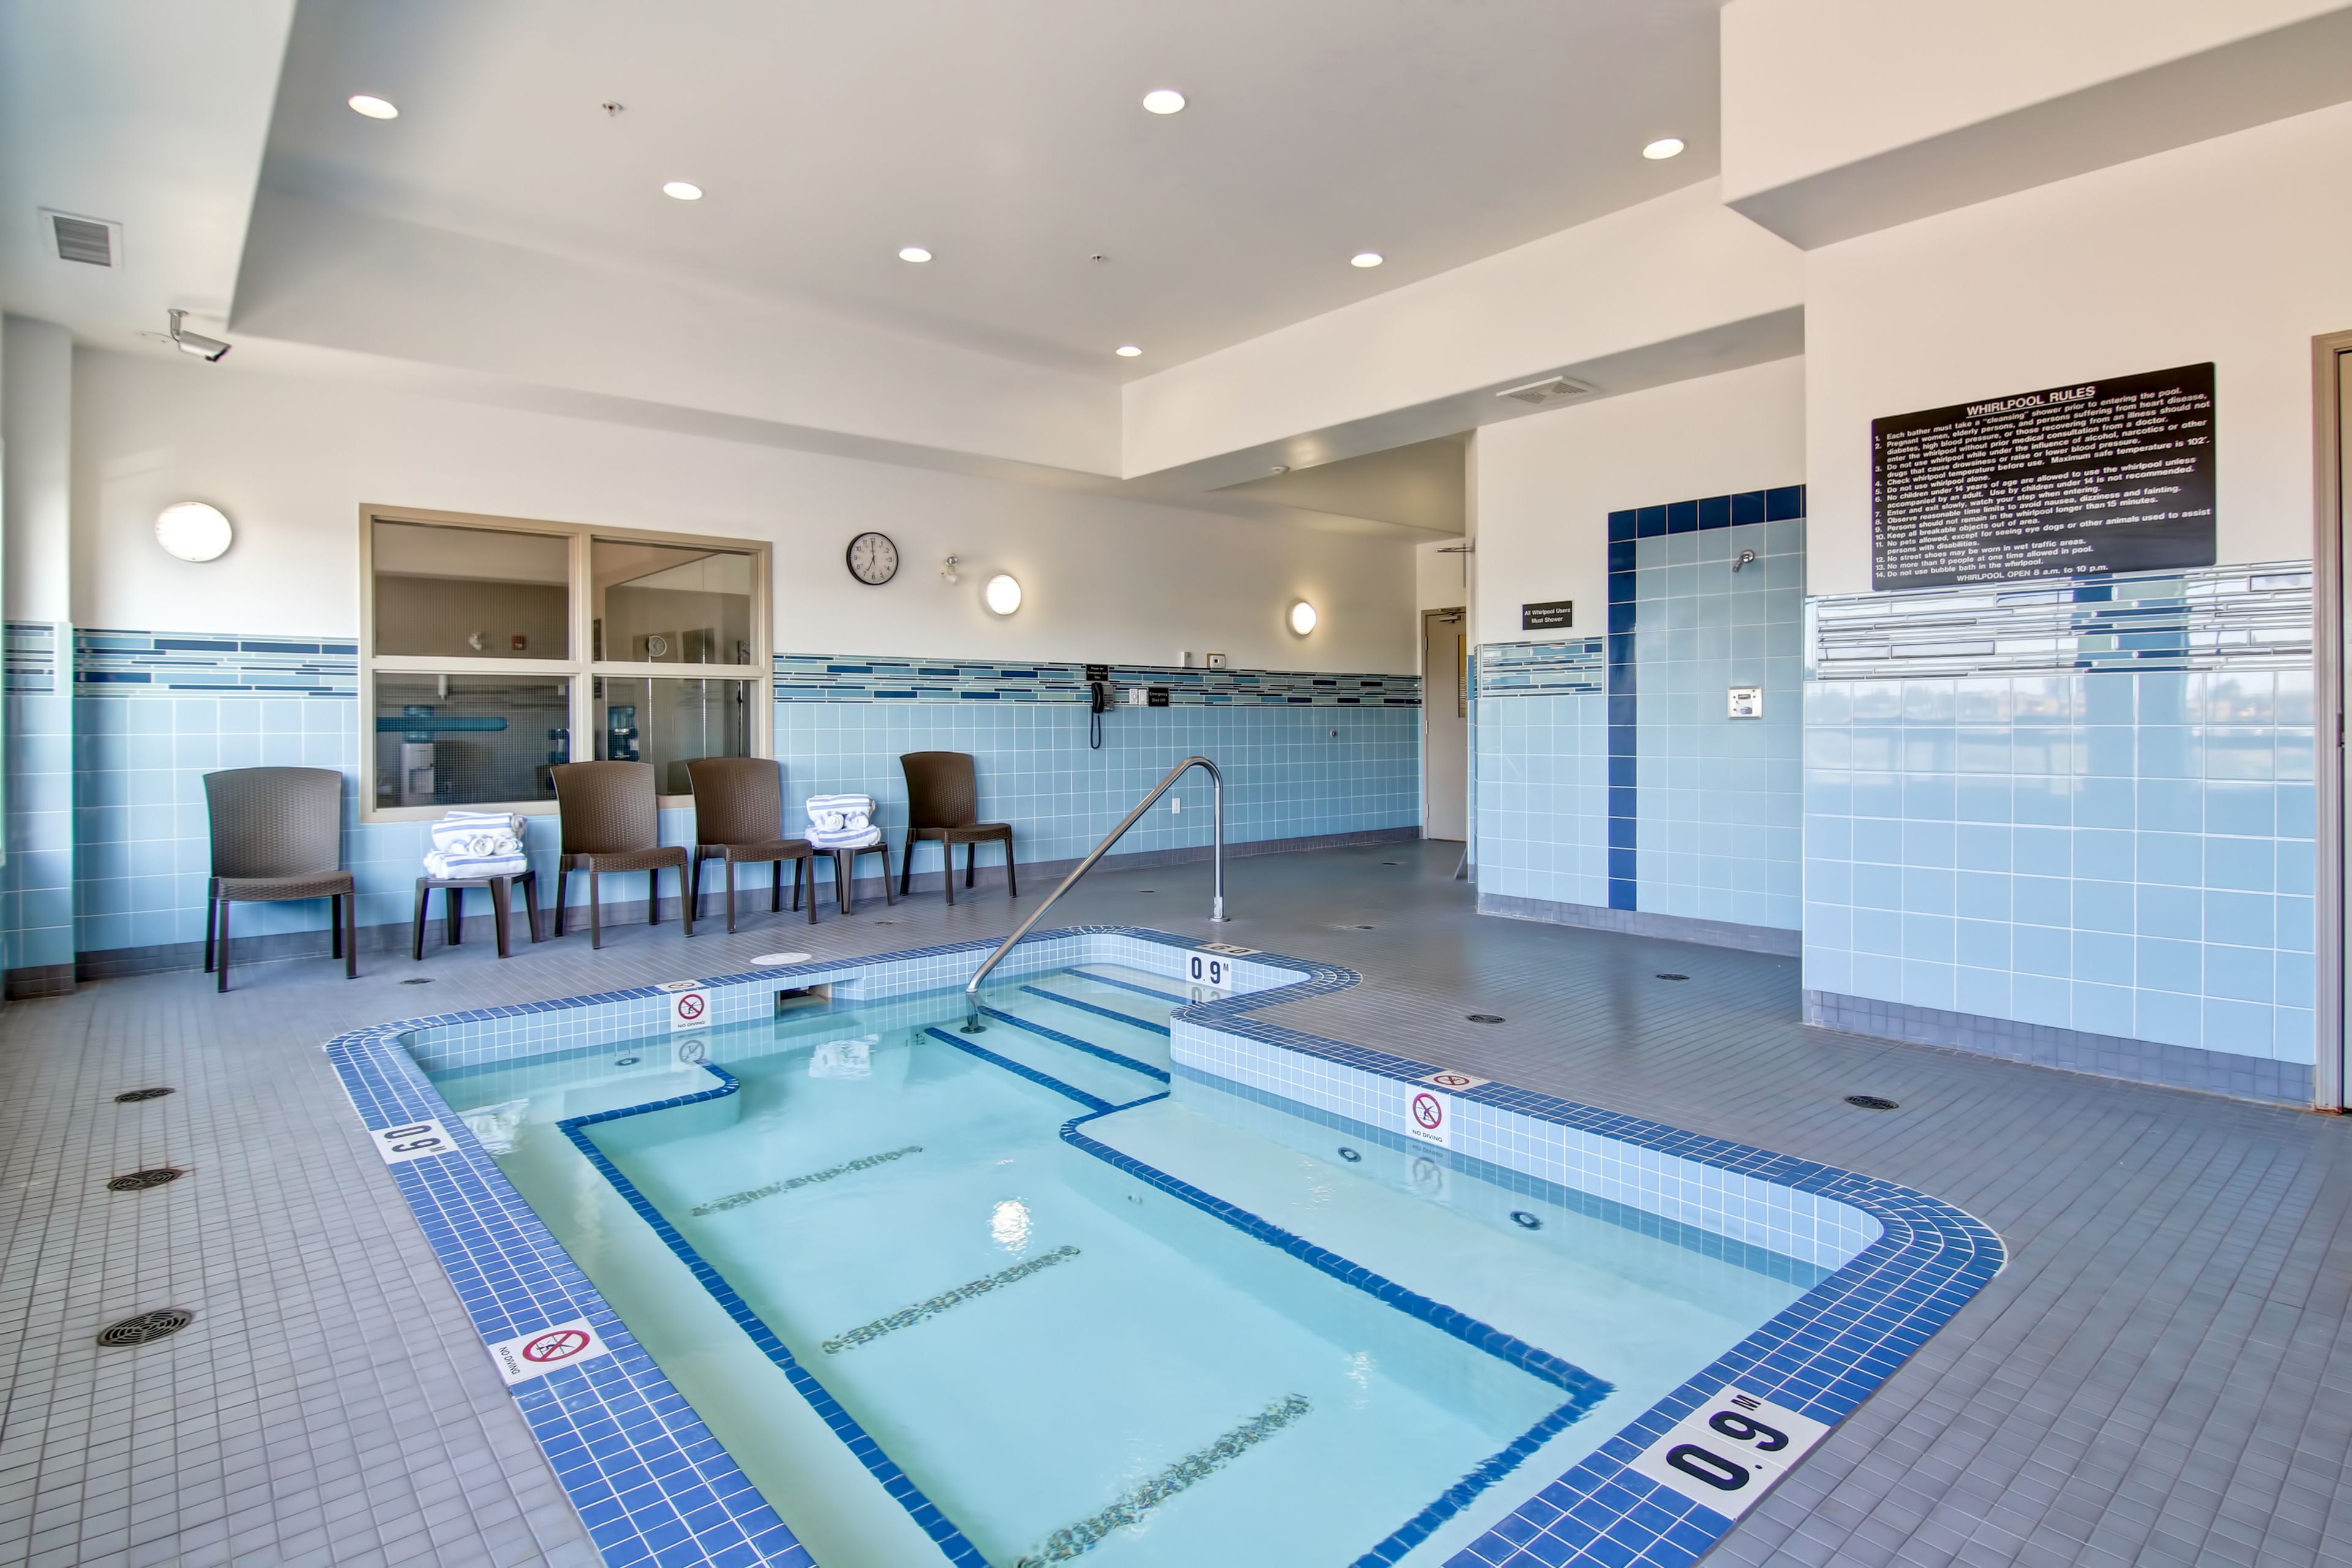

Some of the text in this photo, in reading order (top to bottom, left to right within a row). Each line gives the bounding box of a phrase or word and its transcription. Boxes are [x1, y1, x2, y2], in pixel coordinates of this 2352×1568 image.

[1966, 386, 2095, 416] WHIRLPOOL RULES
[1887, 431, 1905, 440] Each
[1907, 428, 1931, 437] bather
[1933, 424, 1952, 432] must
[2032, 407, 2062, 417] shower
[2064, 403, 2085, 412] prior
[2100, 395, 2137, 405] entering
[2158, 387, 2182, 398] pool.
[1887, 437, 1918, 447] Pregnant
[1921, 433, 1950, 442] women,
[1952, 428, 1978, 437] elderly
[1981, 423, 2016, 434] persons,
[2018, 418, 2034, 427] and
[2036, 413, 2070, 425] persons
[2073, 407, 2113, 418] suffering
[2139, 398, 2164, 409] heart
[2166, 393, 2207, 404] disease,
[1887, 445, 1920, 455] diabetes,
[1940, 437, 1962, 447] blood
[1964, 433, 2002, 444] pressure,
[2016, 427, 2039, 435] those
[2041, 420, 2086, 431] recovering
[2089, 416, 2110, 424] from
[2127, 409, 2156, 418] illness
[2159, 402, 2191, 414] should
[2193, 400, 2210, 409] not
[1930, 453, 1964, 464] whirlpool
[1966, 450, 1986, 459] while
[1989, 447, 2012, 456] under
[2031, 439, 2069, 450] influence
[2084, 431, 2119, 442] alcohol,
[2121, 426, 2165, 437] narcotics
[2181, 420, 2207, 429] other
[1930, 477, 1964, 488] whirlpool
[1887, 515, 1917, 524] Observe
[1920, 510, 1961, 520] reasonable
[2019, 500, 2041, 509] avoid
[2044, 497, 2077, 506] nausea,
[2079, 492, 2120, 502] dizziness
[2143, 485, 2181, 495] fainting.
[1969, 497, 1993, 506] watch
[2063, 486, 2101, 496] entering.
[1919, 526, 1956, 535] breakable
[1959, 522, 1988, 532] objects
[1887, 546, 1917, 556] persons
[1937, 540, 1980, 549] disabilities.
[1948, 556, 1974, 565] people
[2026, 548, 2059, 557] allowed
[2071, 545, 2094, 554] pool.
[2004, 557, 2043, 567] whirlpool.
[1956, 571, 2005, 581] WHIRLPOOL
[1423, 1132, 1442, 1142] DIVING
[499, 1347, 520, 1375] NO DIVING
